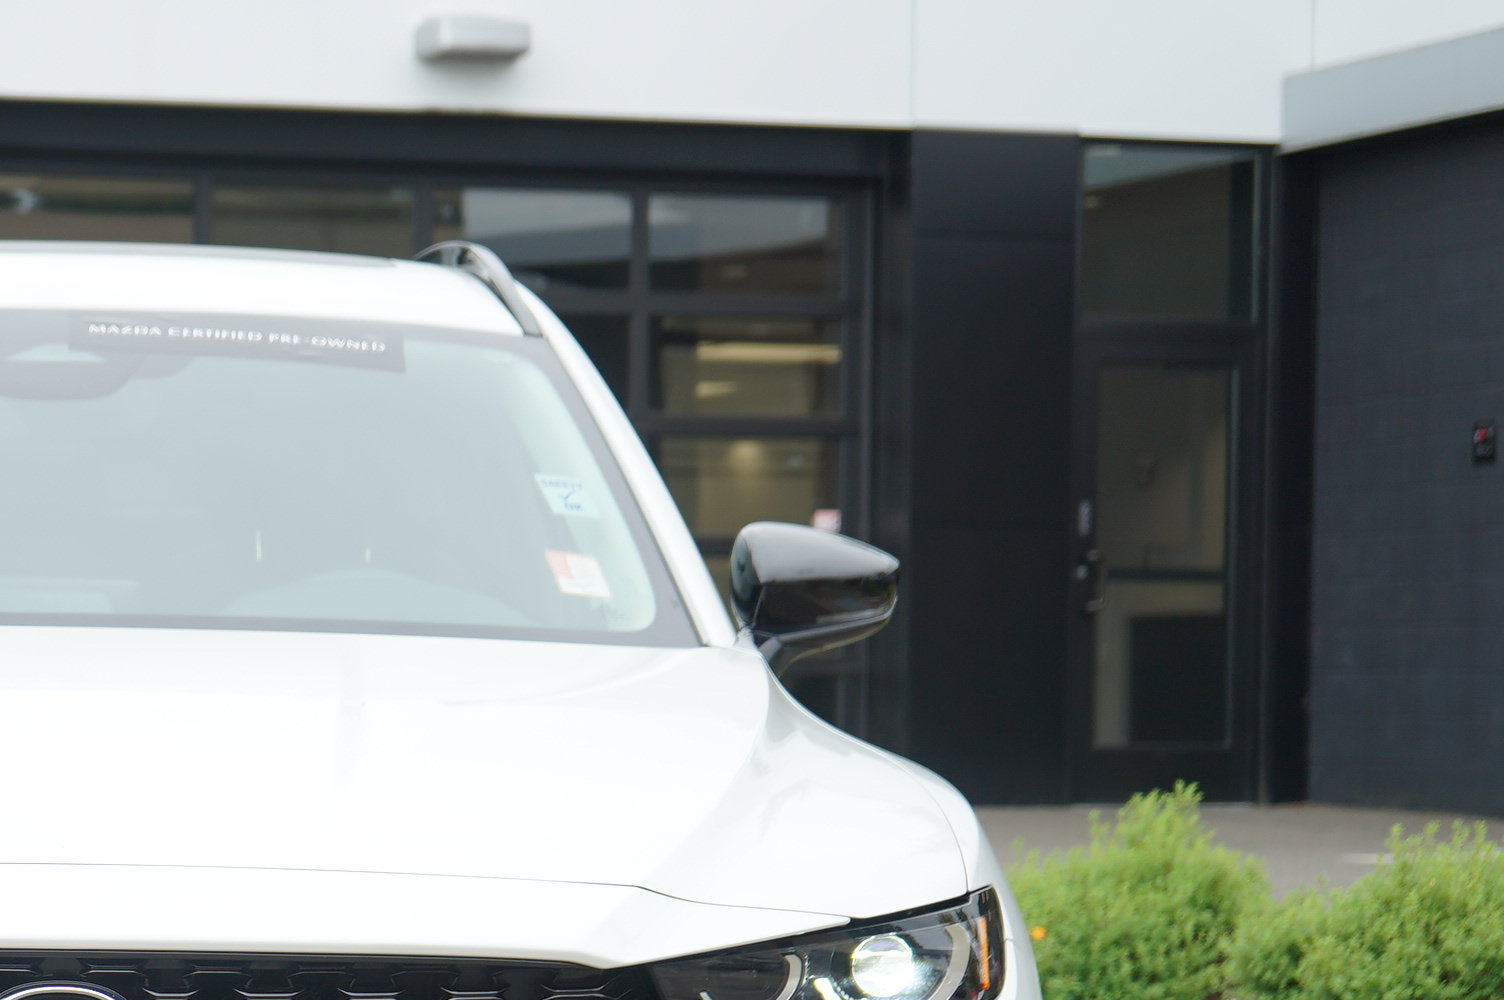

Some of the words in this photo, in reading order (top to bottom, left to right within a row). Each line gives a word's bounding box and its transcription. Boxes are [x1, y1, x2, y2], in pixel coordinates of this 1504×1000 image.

[88, 323, 162, 337] MAZDA
[167, 325, 263, 342] CERTIFIED
[268, 332, 386, 353] PRE-OWNED
